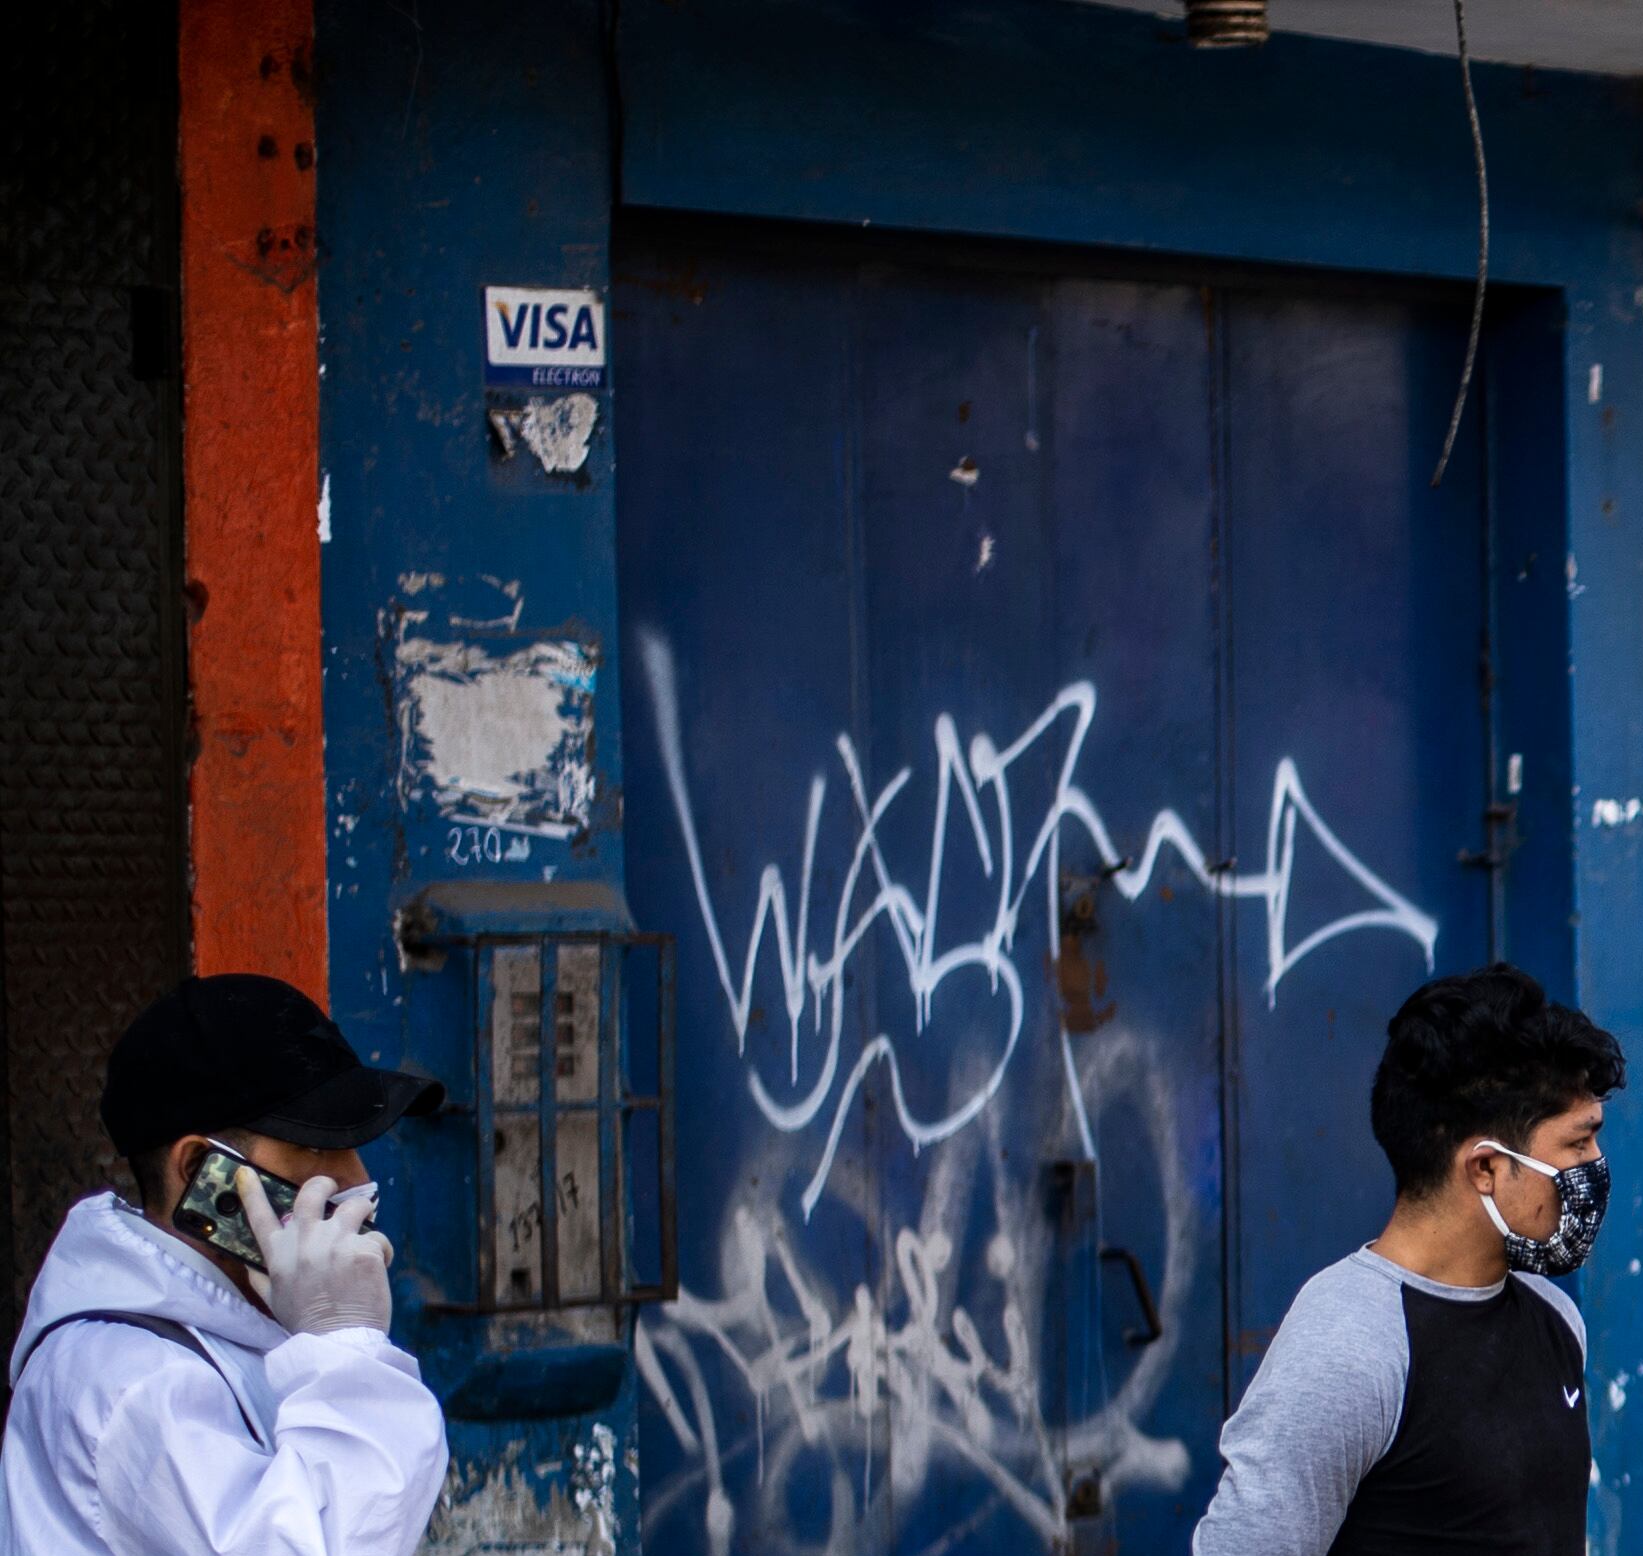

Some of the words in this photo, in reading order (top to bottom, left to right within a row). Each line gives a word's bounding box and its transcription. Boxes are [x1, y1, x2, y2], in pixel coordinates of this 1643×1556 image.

[495, 300, 598, 350] VISA
[532, 367, 601, 386] ELECTRON
[447, 826, 502, 866] 270
